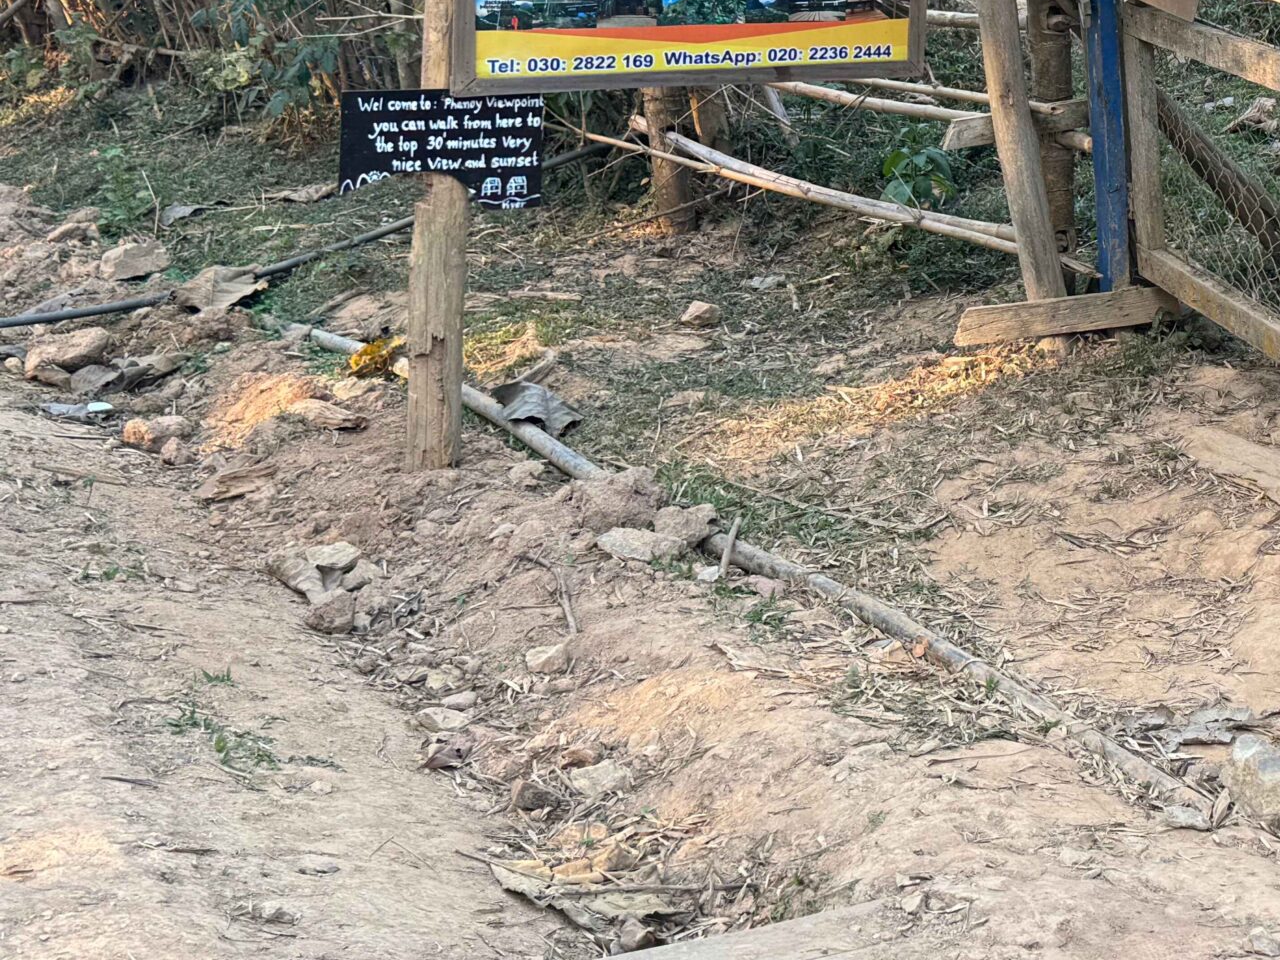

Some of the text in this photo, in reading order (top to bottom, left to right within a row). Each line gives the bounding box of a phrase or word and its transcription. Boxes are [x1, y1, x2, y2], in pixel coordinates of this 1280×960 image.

[487, 44, 892, 74] Tel: 030: 2822 169 WhatsApp: 020: 2236 2444
[486, 96, 544, 112] Viewpoint
[368, 112, 541, 139] you can walk from here to
[375, 137, 393, 153] the
[398, 136, 418, 157] top
[446, 133, 497, 149] minutes
[464, 154, 486, 169] and
[491, 151, 539, 168] sunset
